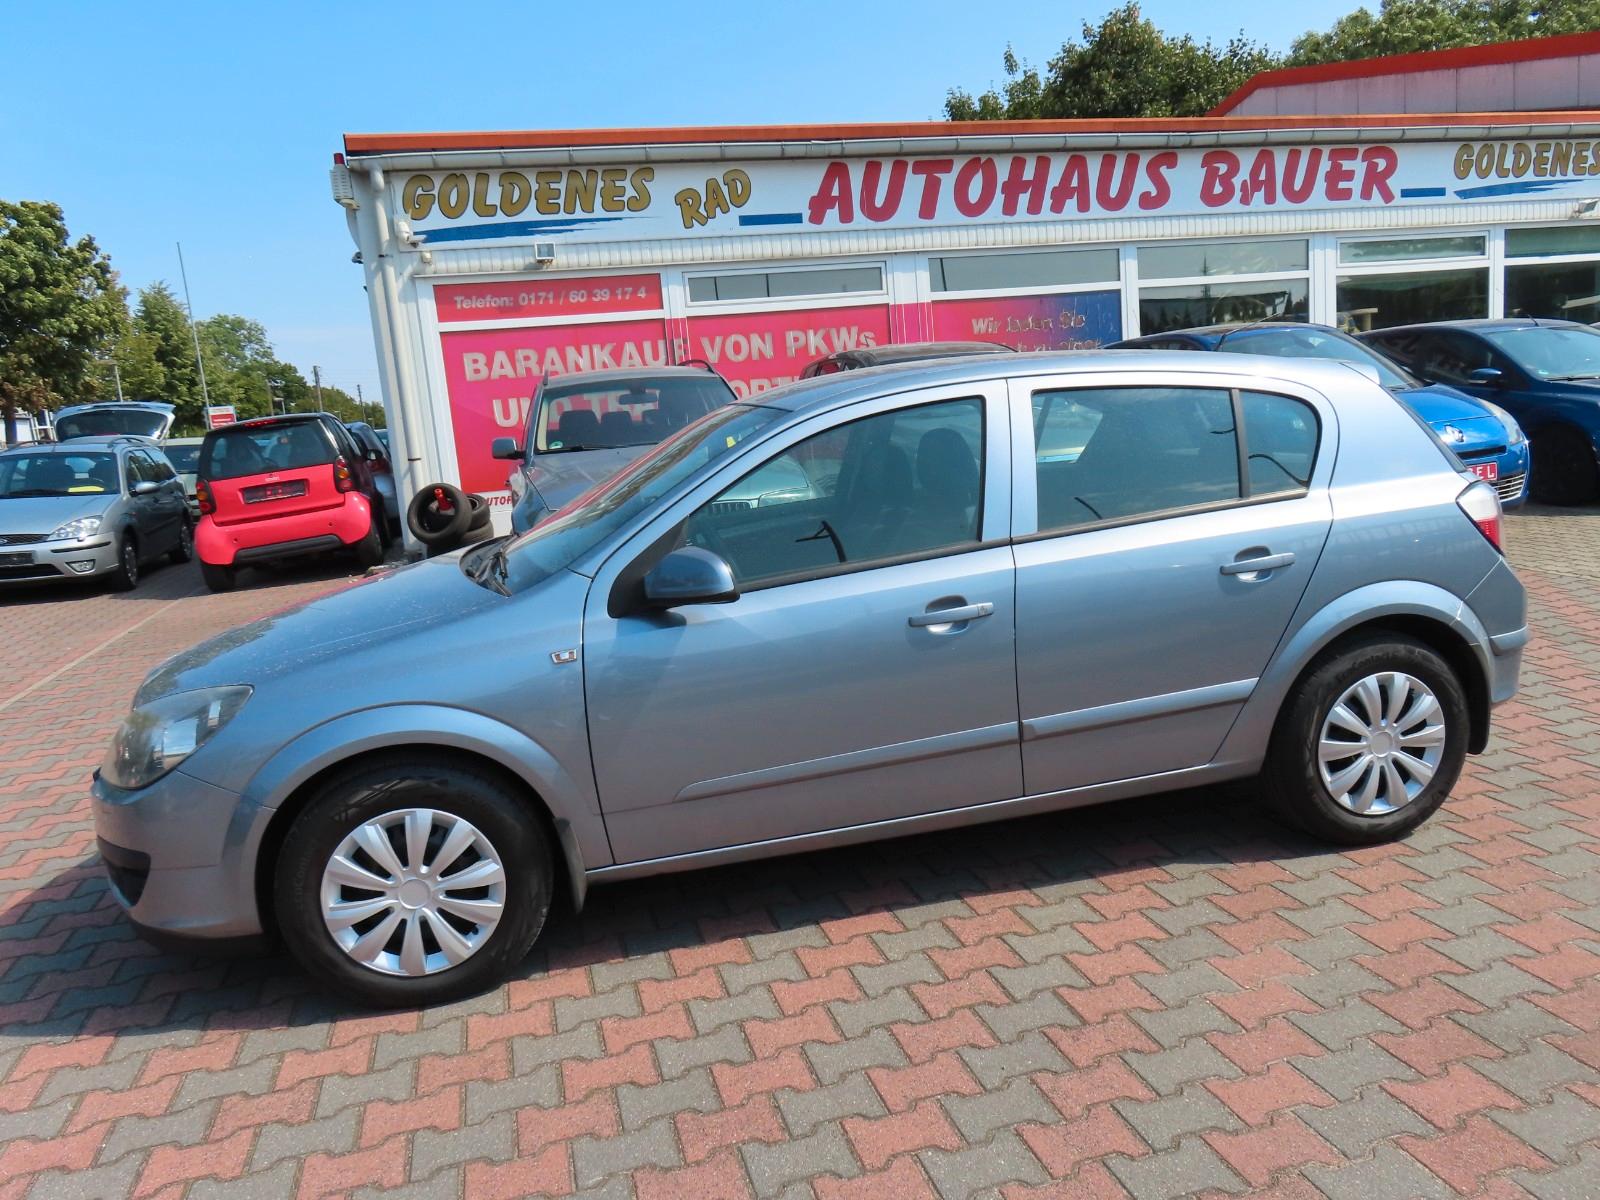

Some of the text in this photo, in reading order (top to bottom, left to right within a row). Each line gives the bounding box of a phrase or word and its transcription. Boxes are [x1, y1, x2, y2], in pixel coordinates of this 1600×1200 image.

[402, 166, 752, 229] GOLDENES RAD
[808, 145, 1398, 225] AUTOHAUS BAUER
[454, 295, 513, 310] Telefon:
[518, 292, 555, 306] 0171
[569, 290, 587, 304] 60
[592, 288, 610, 302] 39
[616, 287, 632, 301] 17
[637, 286, 646, 299] 4
[700, 332, 774, 363] VON
[785, 325, 877, 358] PKWs
[1468, 465, 1495, 479] EL
